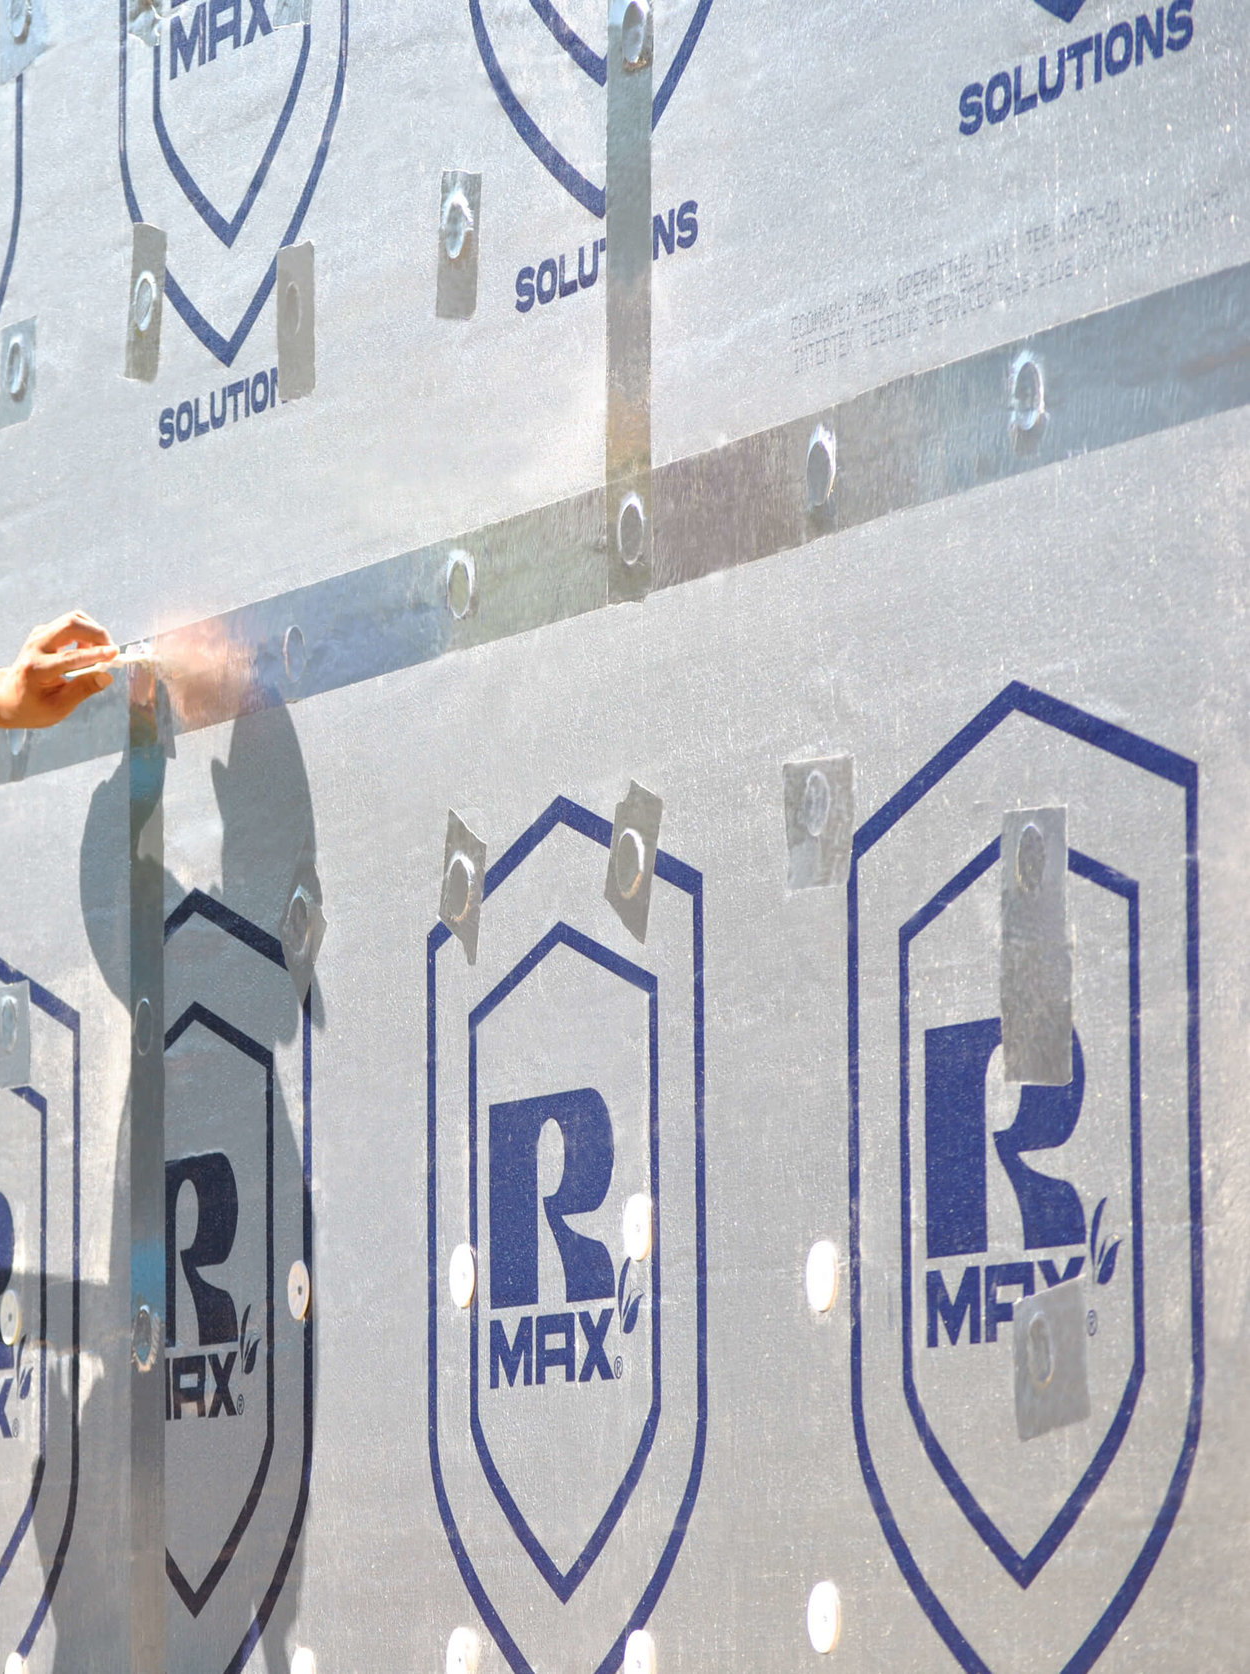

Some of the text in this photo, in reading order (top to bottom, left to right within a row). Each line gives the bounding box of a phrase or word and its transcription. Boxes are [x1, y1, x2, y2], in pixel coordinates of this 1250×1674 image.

[170, 0, 274, 80] MAX
[959, 0, 1195, 136] SOLUTIONS
[515, 200, 699, 313] SOLUNS
[488, 1087, 616, 1310] R
[924, 1017, 1087, 1259] R
[165, 1152, 239, 1349] R
[165, 1352, 237, 1421] AX
[489, 1307, 615, 1390] MAX
